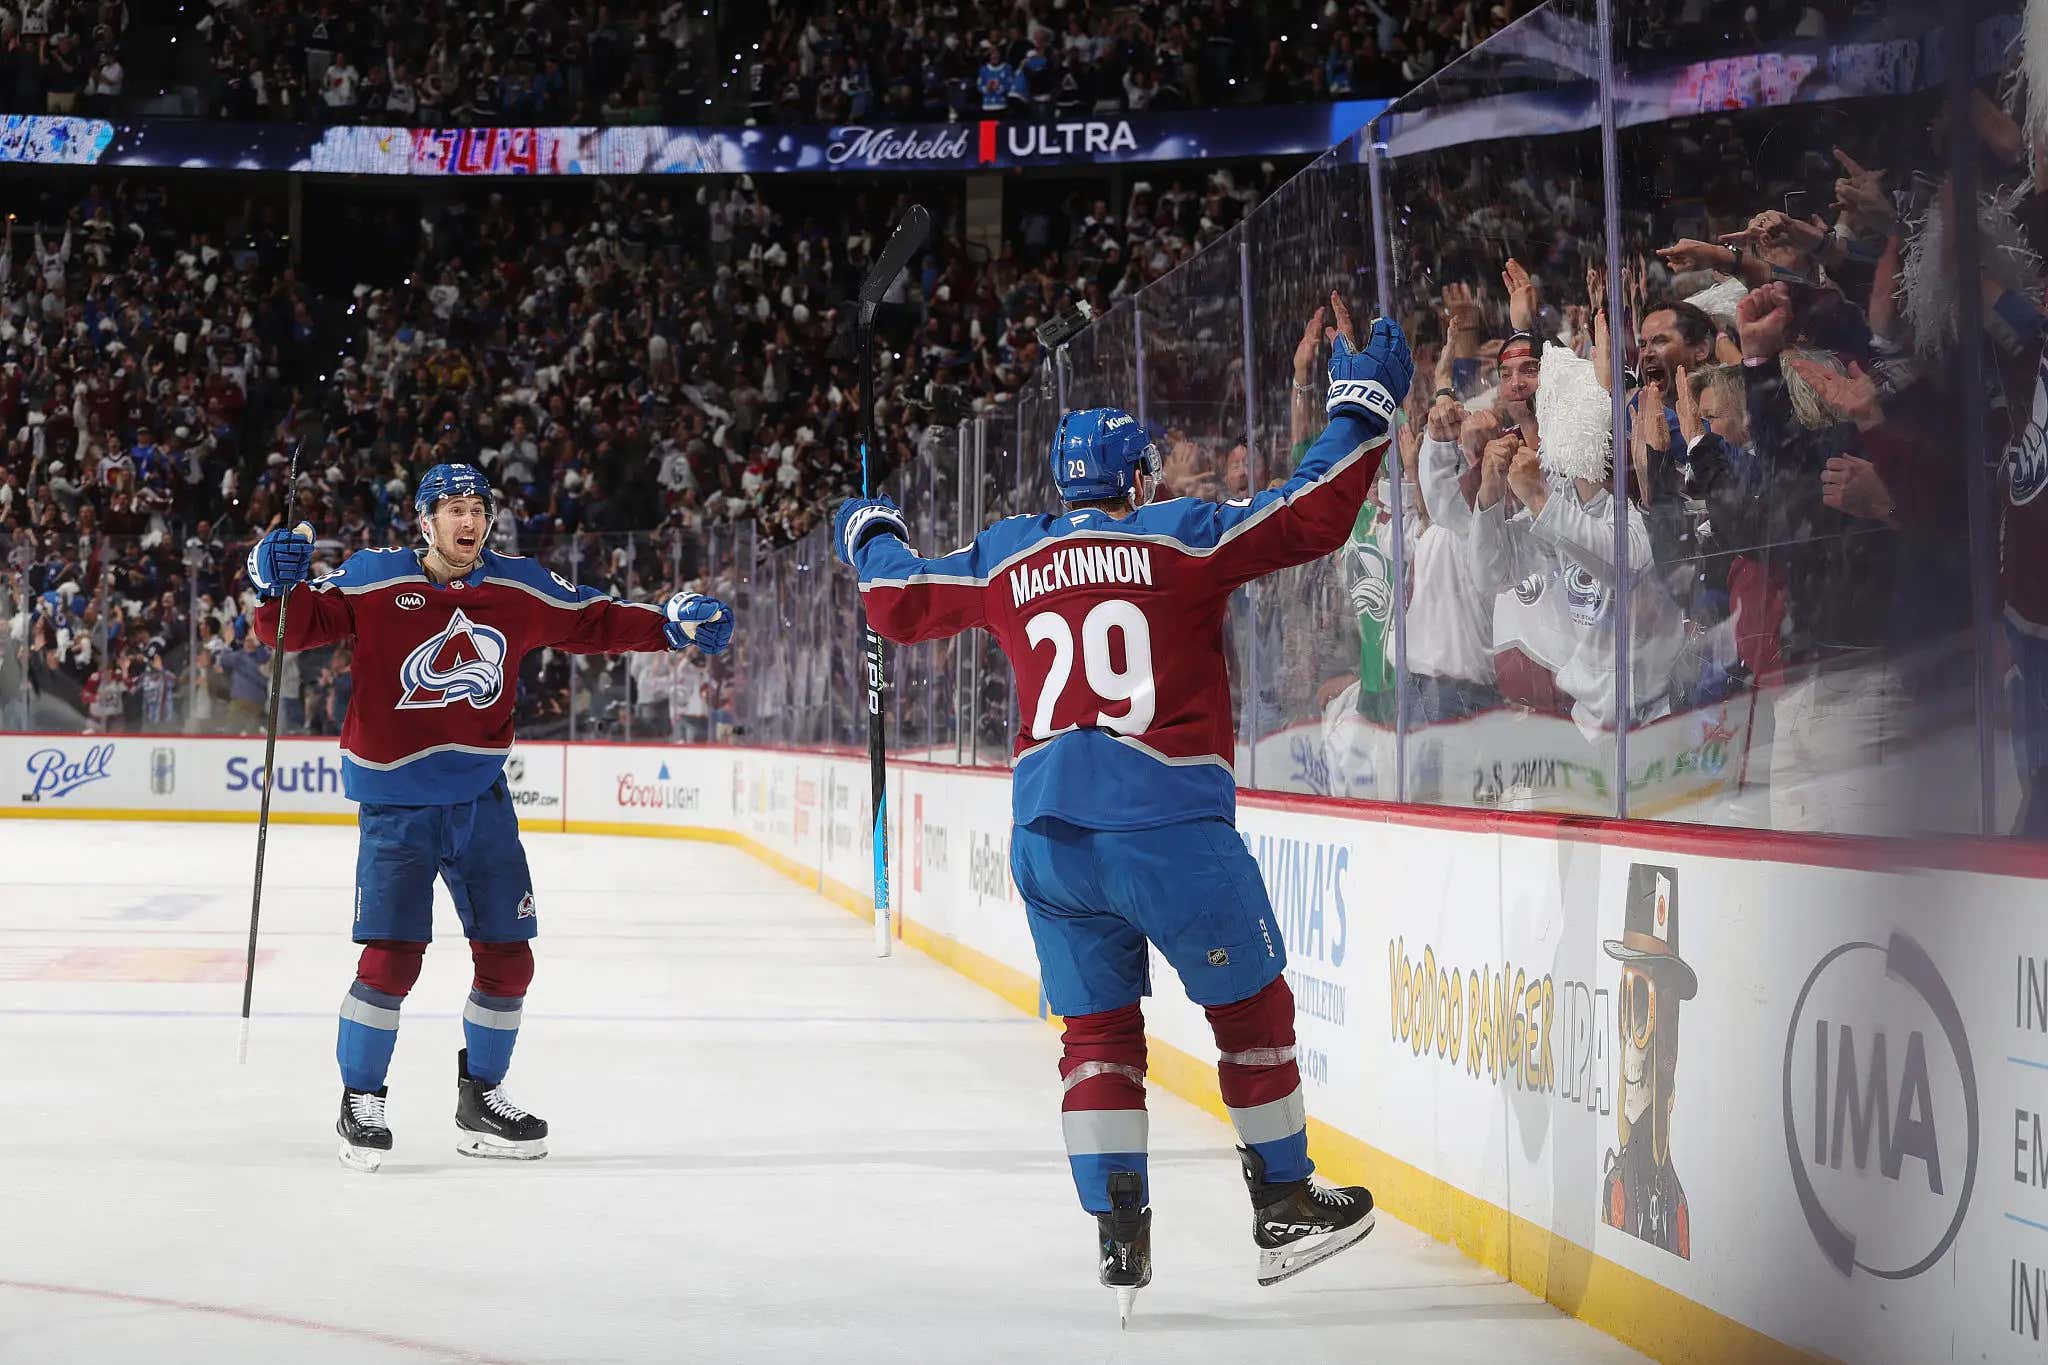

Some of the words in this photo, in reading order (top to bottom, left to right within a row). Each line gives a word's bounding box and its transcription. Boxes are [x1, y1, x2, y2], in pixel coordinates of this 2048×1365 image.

[827, 126, 967, 164] Michelob
[1008, 121, 1137, 155] ULTRA
[1067, 459, 1086, 479] 29
[400, 596, 421, 606] IMA
[1025, 599, 1156, 740] 29
[26, 743, 115, 798] Ball
[226, 756, 343, 793] South
[616, 773, 664, 808] Coors
[665, 785, 701, 810] LIGHT
[1259, 917, 1276, 958] CCM
[1297, 972, 1346, 1028] LITTLETON
[1389, 935, 1464, 1067] VOODOO
[1467, 960, 1556, 1094] RANGER
[1561, 981, 1612, 1116] IPA
[1814, 1018, 1945, 1196] IMA
[1264, 1221, 1335, 1236] CCM
